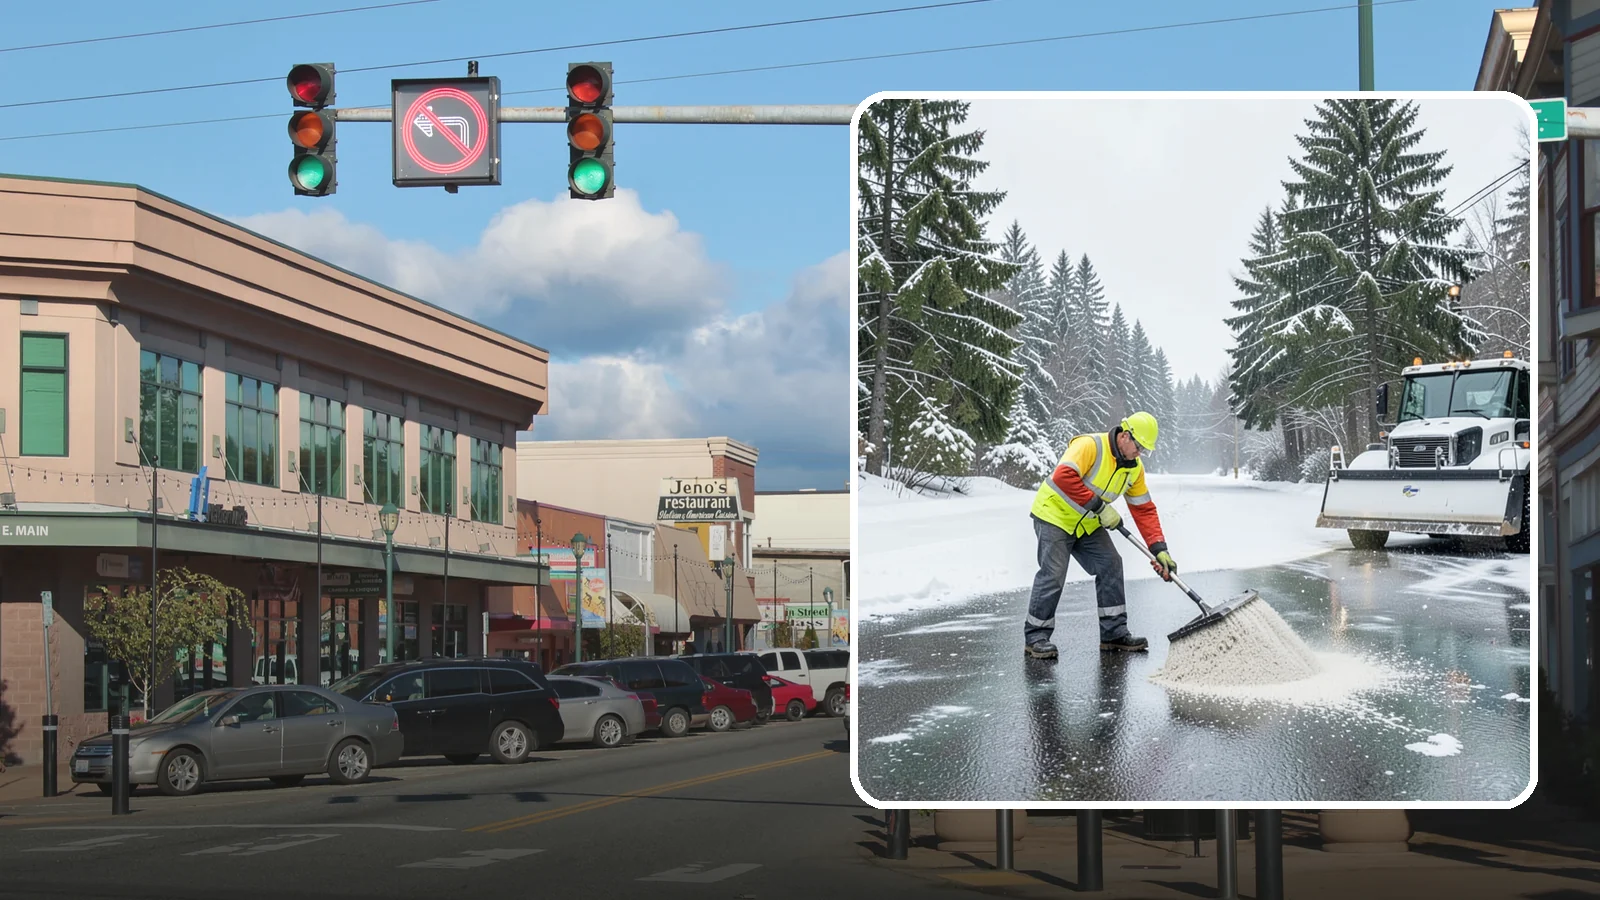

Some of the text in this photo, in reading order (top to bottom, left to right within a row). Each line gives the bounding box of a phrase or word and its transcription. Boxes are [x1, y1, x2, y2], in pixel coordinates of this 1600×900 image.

[669, 480, 727, 494] Jeno's
[665, 496, 731, 508] restaurant
[659, 510, 682, 519] Italian
[686, 510, 714, 519] American
[715, 509, 737, 519] Cuisine
[2, 525, 49, 536] E. MAIN
[797, 608, 828, 617] Street
